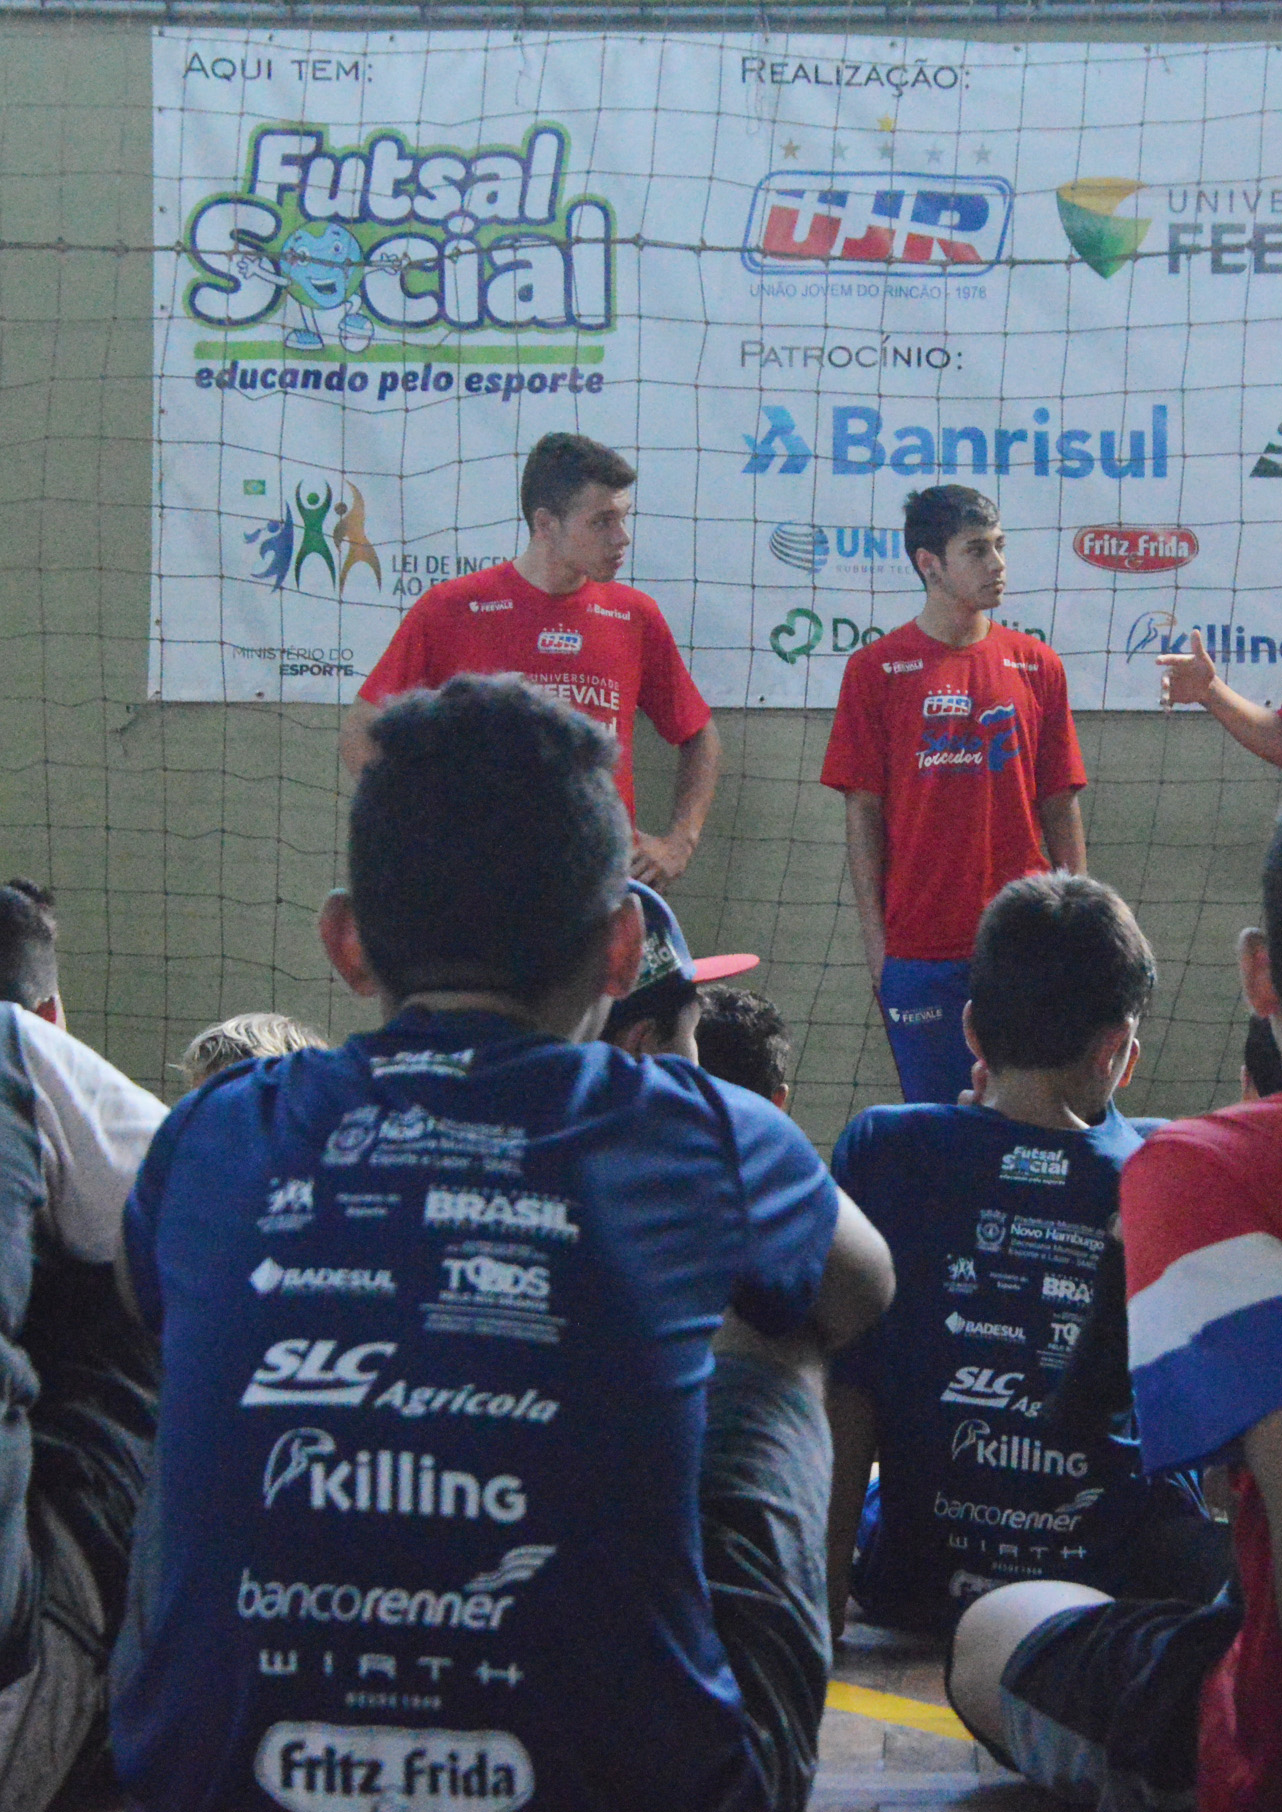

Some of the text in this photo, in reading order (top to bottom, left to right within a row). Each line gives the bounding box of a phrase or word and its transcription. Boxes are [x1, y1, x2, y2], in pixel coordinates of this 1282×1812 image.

[183, 53, 374, 83] AQUI TEM:
[741, 56, 972, 98] REALIZAÇÃO:
[250, 126, 566, 225] Futsal
[762, 189, 991, 263] UJR
[750, 282, 798, 298] UNIÃO
[801, 284, 851, 297] JOVEM
[857, 284, 880, 297] DO
[884, 283, 942, 299] RINCÃO
[740, 335, 963, 368] PATROCÍNIO:
[195, 360, 605, 402] educando pelo esporte
[832, 404, 1168, 479] Banrisul
[1082, 532, 1189, 558] Fritz Frida
[392, 554, 418, 573] LEI
[425, 555, 450, 575] DE
[392, 576, 423, 596] AO
[594, 603, 631, 621] Banrisul
[232, 645, 354, 661] MINISTÉRIO DO
[280, 664, 354, 677] ESPORTE
[531, 672, 620, 691] UNIVERSIDADE
[915, 747, 984, 769] Torcedor
[1013, 1146, 1063, 1162] Futsal
[424, 1188, 581, 1238] BRASIL
[1011, 1223, 1043, 1239] Novo
[1045, 1228, 1105, 1252] Hamburgo
[965, 1321, 1027, 1340] BADESUL
[252, 1338, 399, 1384] SLC
[950, 1366, 1025, 1396] SLC
[934, 1491, 1082, 1531] bancorenner
[237, 1566, 515, 1631] bancorenner
